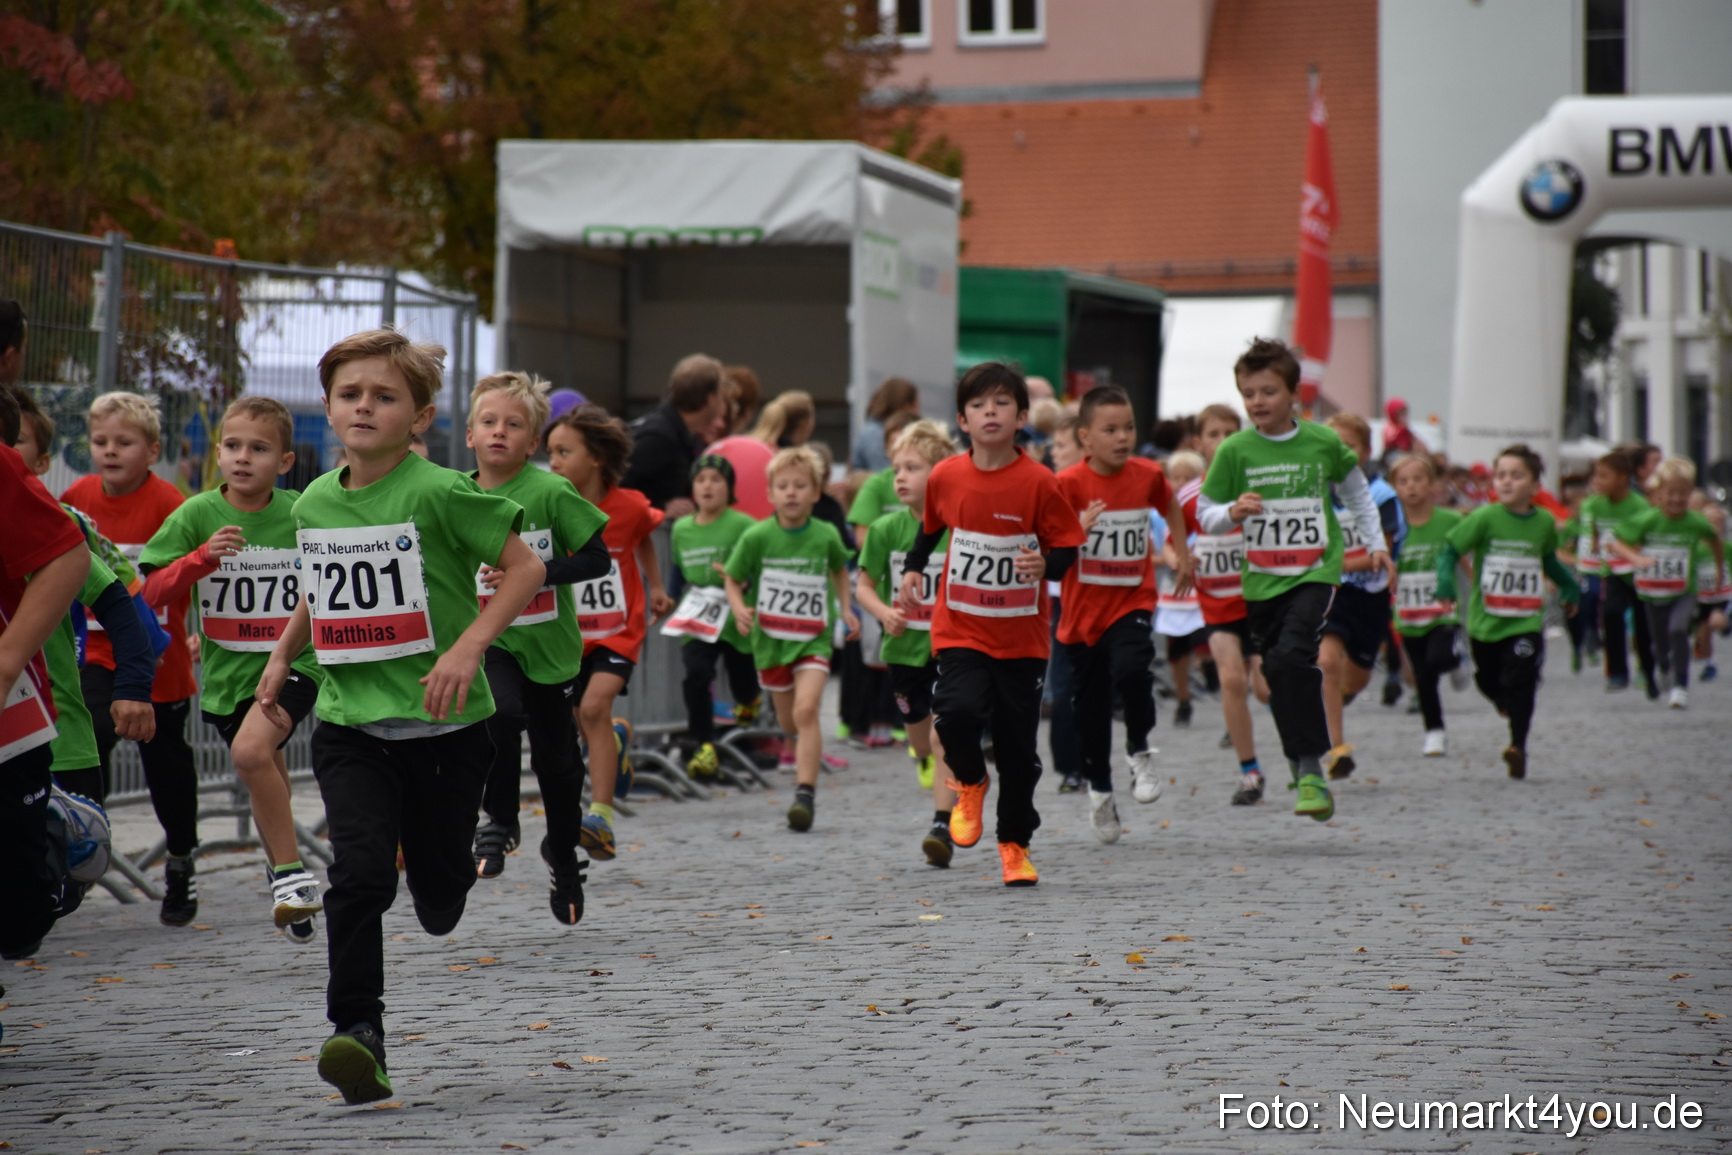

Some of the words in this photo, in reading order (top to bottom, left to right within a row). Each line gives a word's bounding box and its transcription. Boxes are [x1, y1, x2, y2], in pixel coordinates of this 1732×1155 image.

[1608, 124, 1732, 176] BM
[328, 540, 391, 556] Neumarkt
[240, 560, 291, 572] Neumarkt
[980, 593, 1005, 606] Luis
[238, 623, 275, 638] Marc
[321, 624, 397, 645] Matthias
